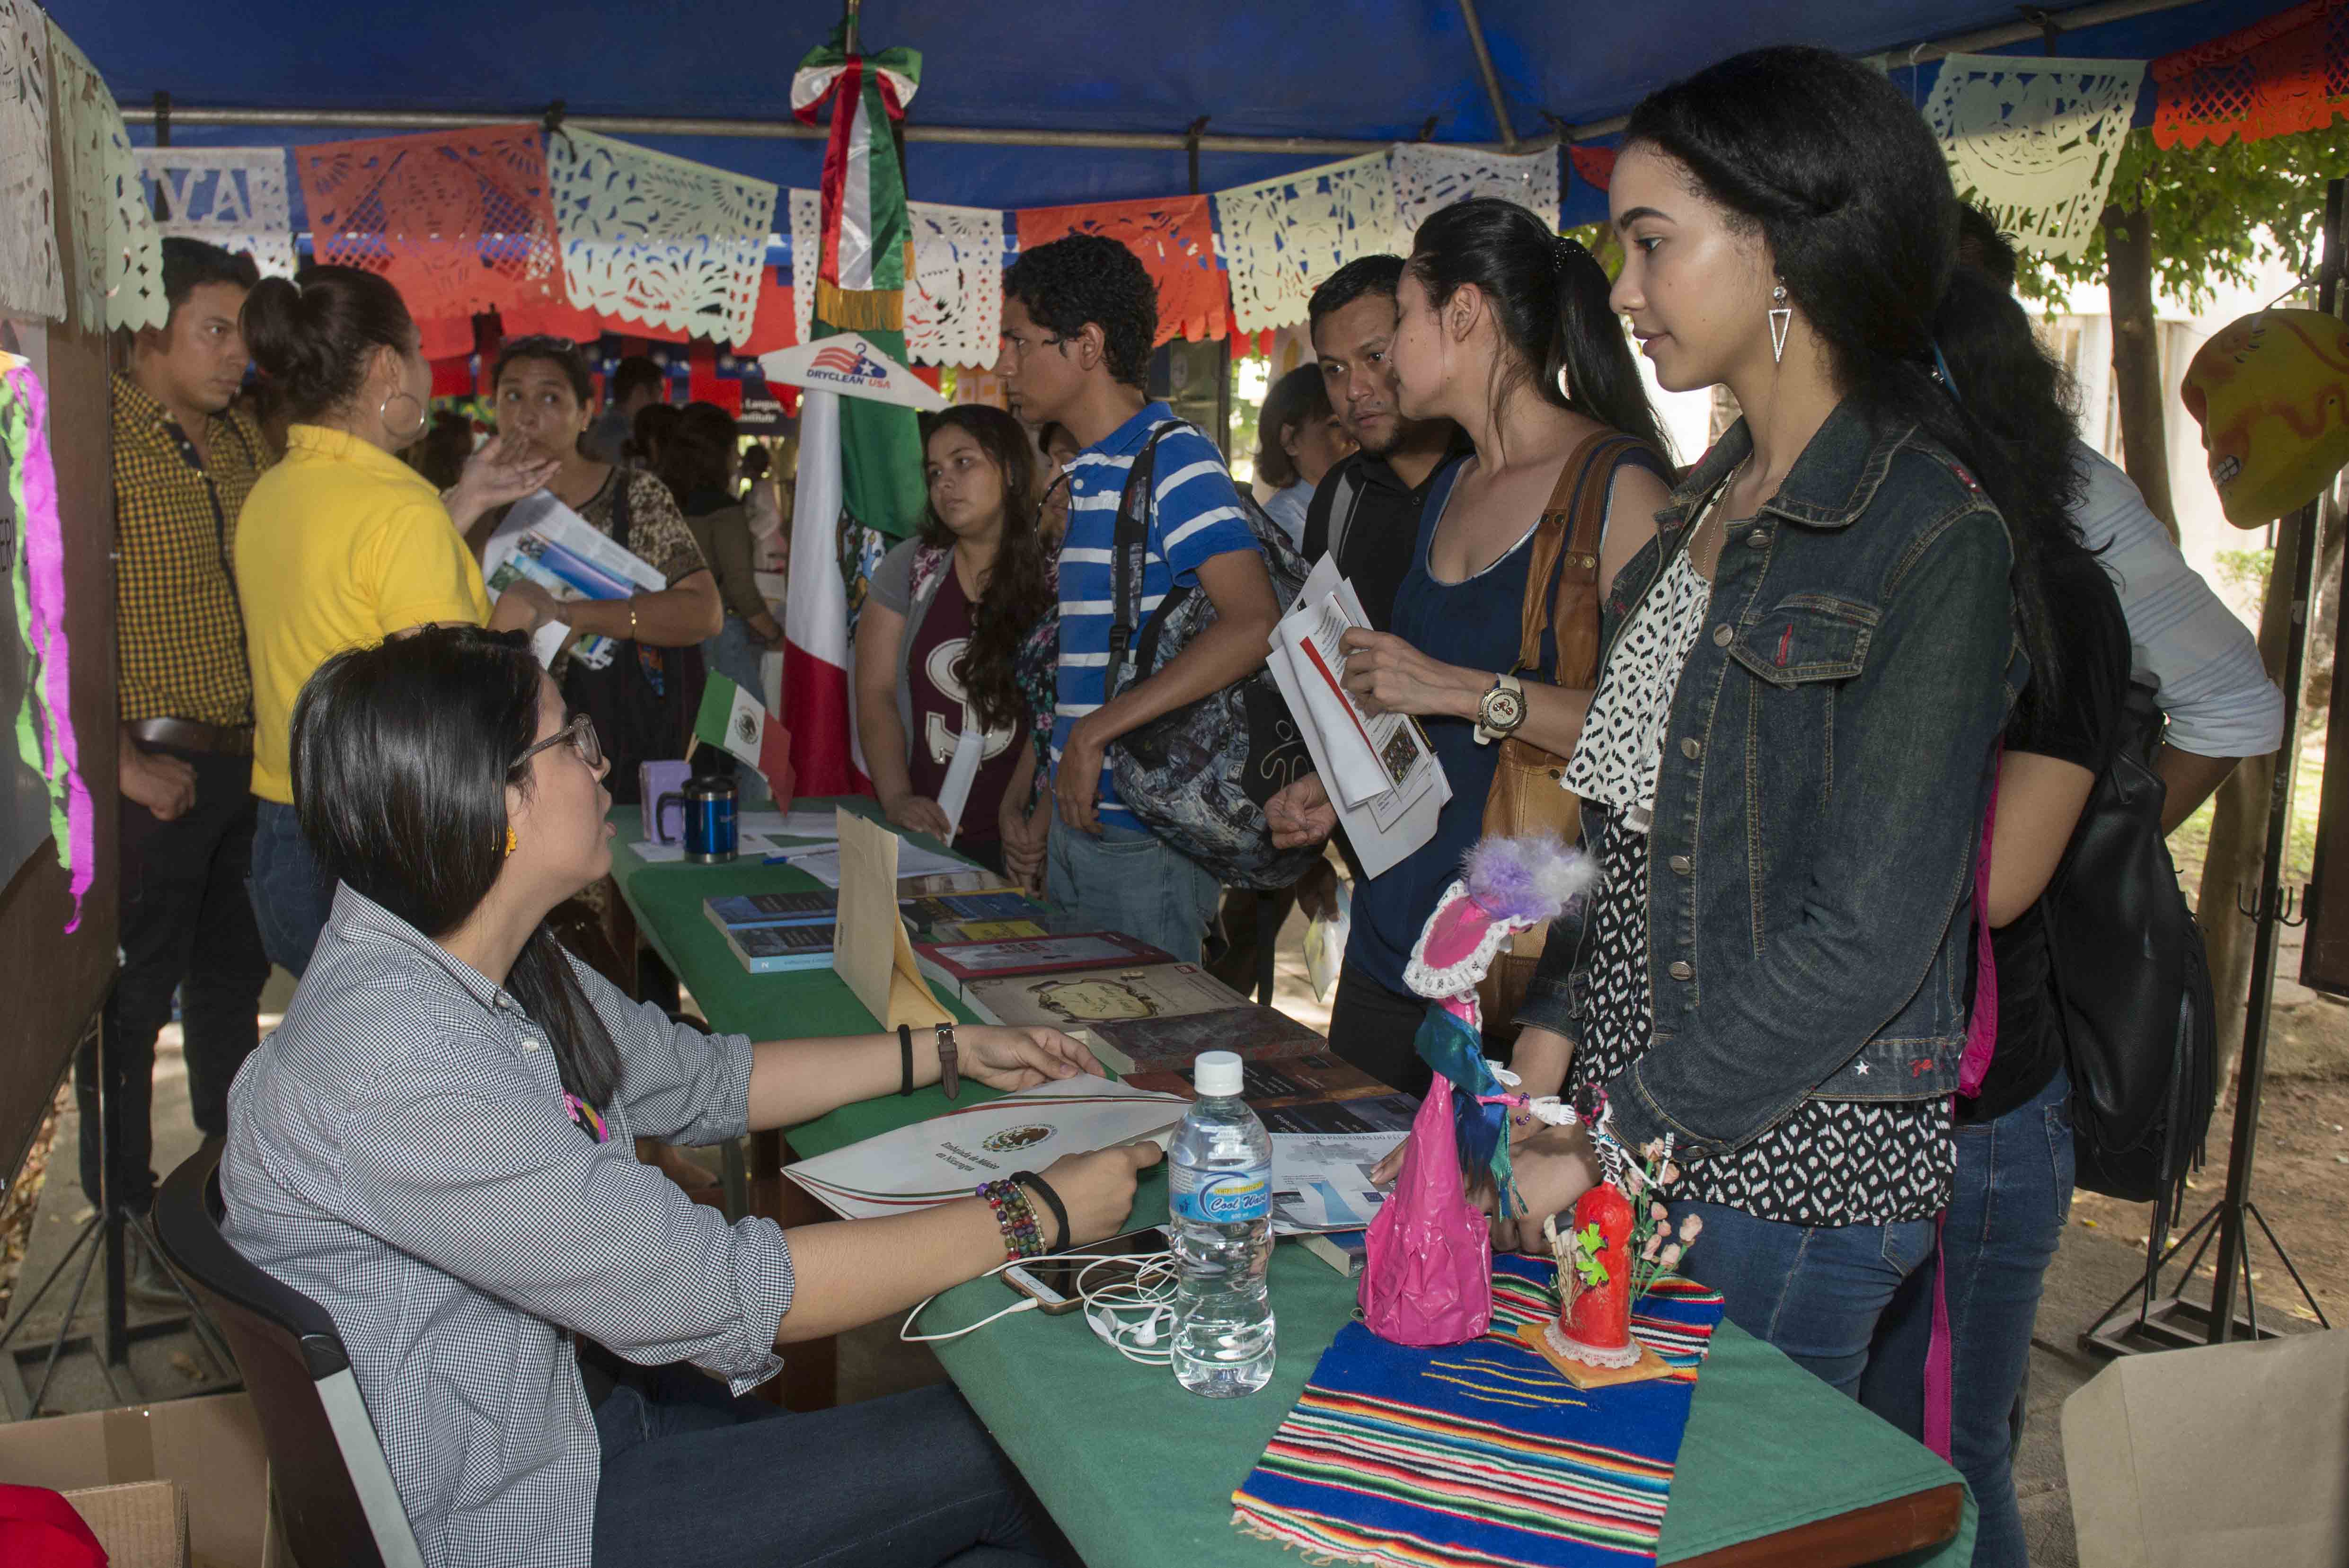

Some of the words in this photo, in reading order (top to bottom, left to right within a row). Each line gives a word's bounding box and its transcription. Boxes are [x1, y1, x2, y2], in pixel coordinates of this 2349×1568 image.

[806, 369, 864, 385] DRYCLEAN
[868, 378, 891, 389] USA
[1210, 1197, 1240, 1212] Cool
